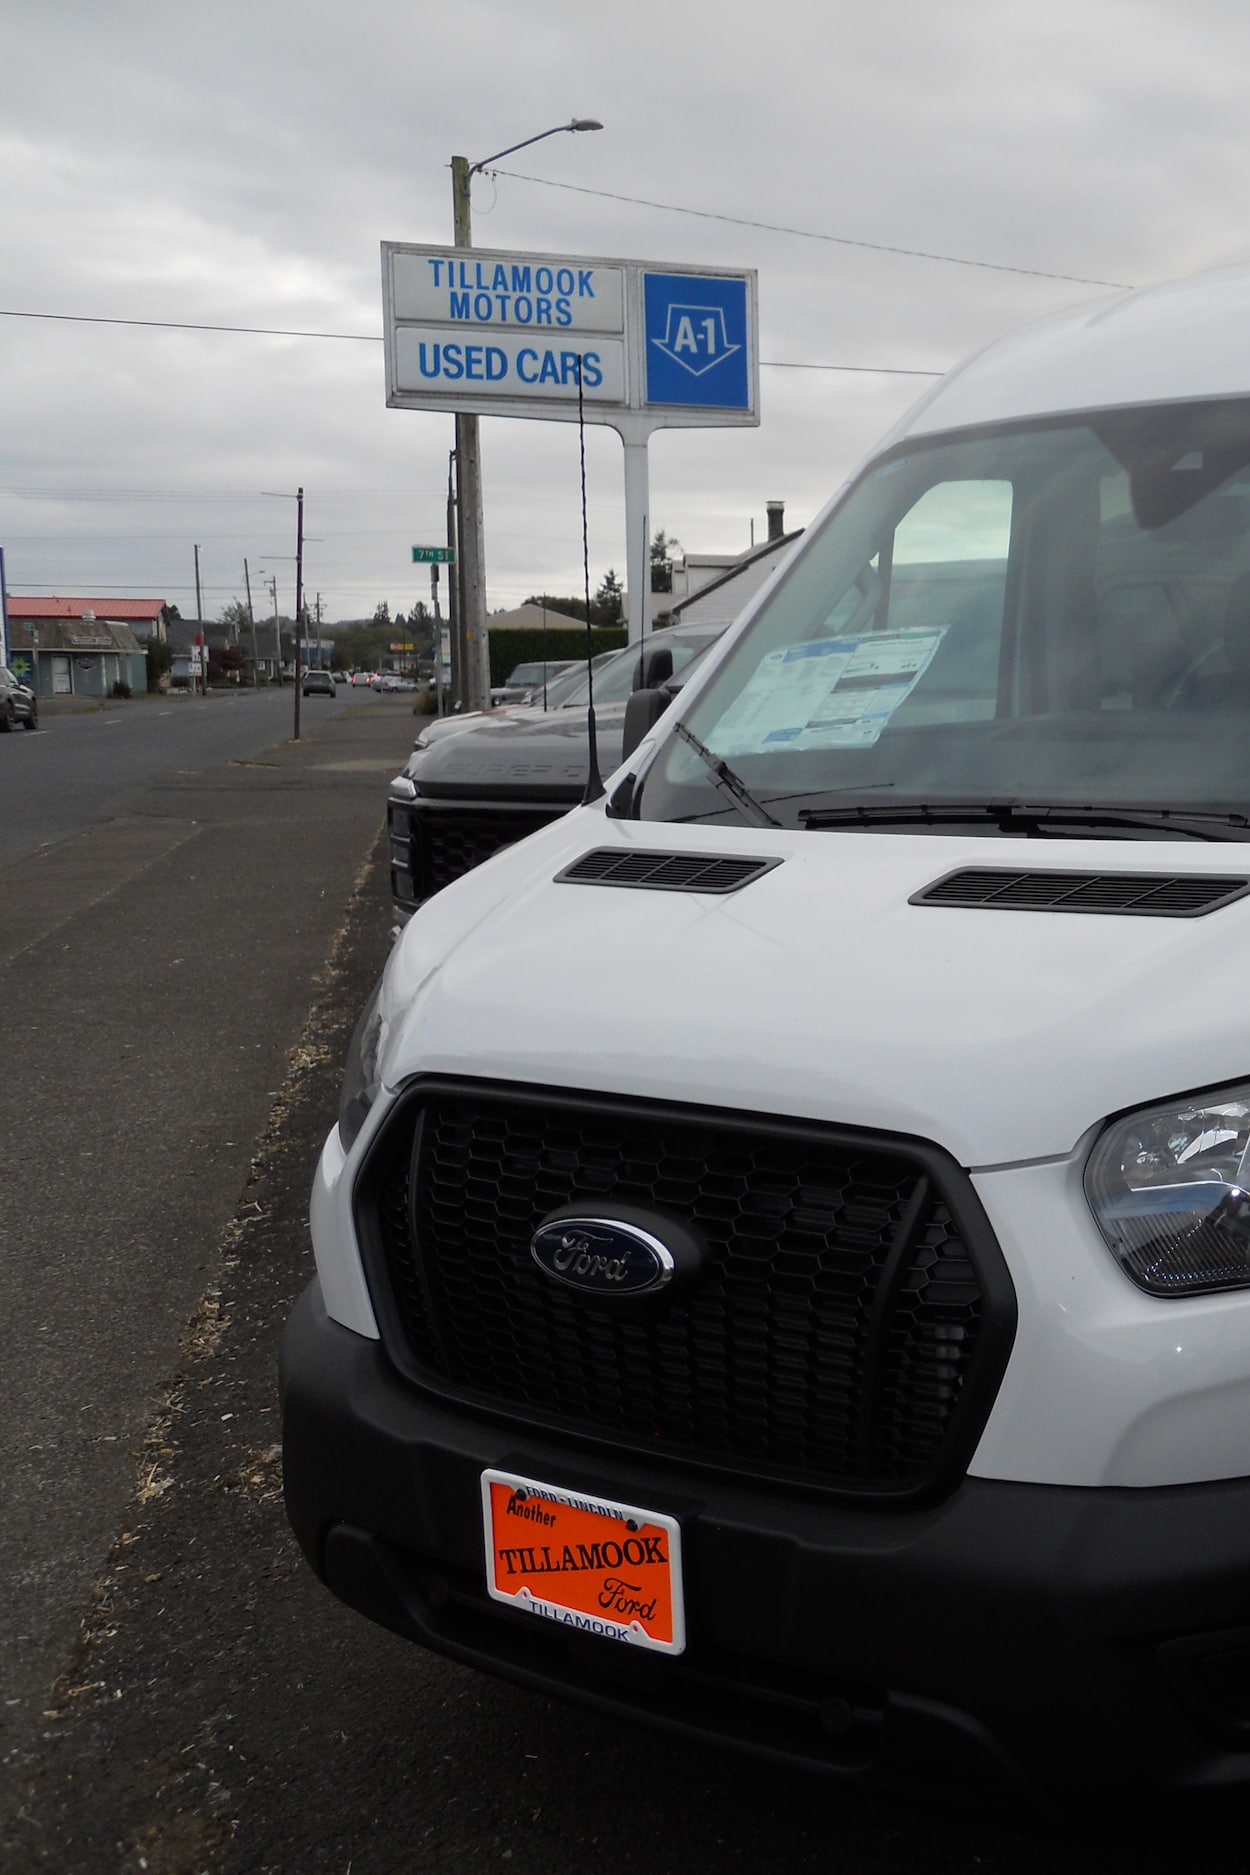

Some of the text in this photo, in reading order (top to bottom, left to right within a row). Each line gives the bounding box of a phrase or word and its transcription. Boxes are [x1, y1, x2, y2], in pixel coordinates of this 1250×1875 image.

[427, 258, 595, 297] TILLAMOOK
[449, 292, 573, 326] MOTORS
[673, 315, 716, 355] A-1
[418, 342, 603, 387] USED CARS
[553, 1229, 632, 1281] Ford
[506, 1495, 557, 1528] Another
[567, 1497, 625, 1521] LINCOLN
[499, 1537, 668, 1575] TILLAMOOK
[598, 1577, 657, 1621] Ford
[529, 1600, 630, 1642] TILLAMOOK
